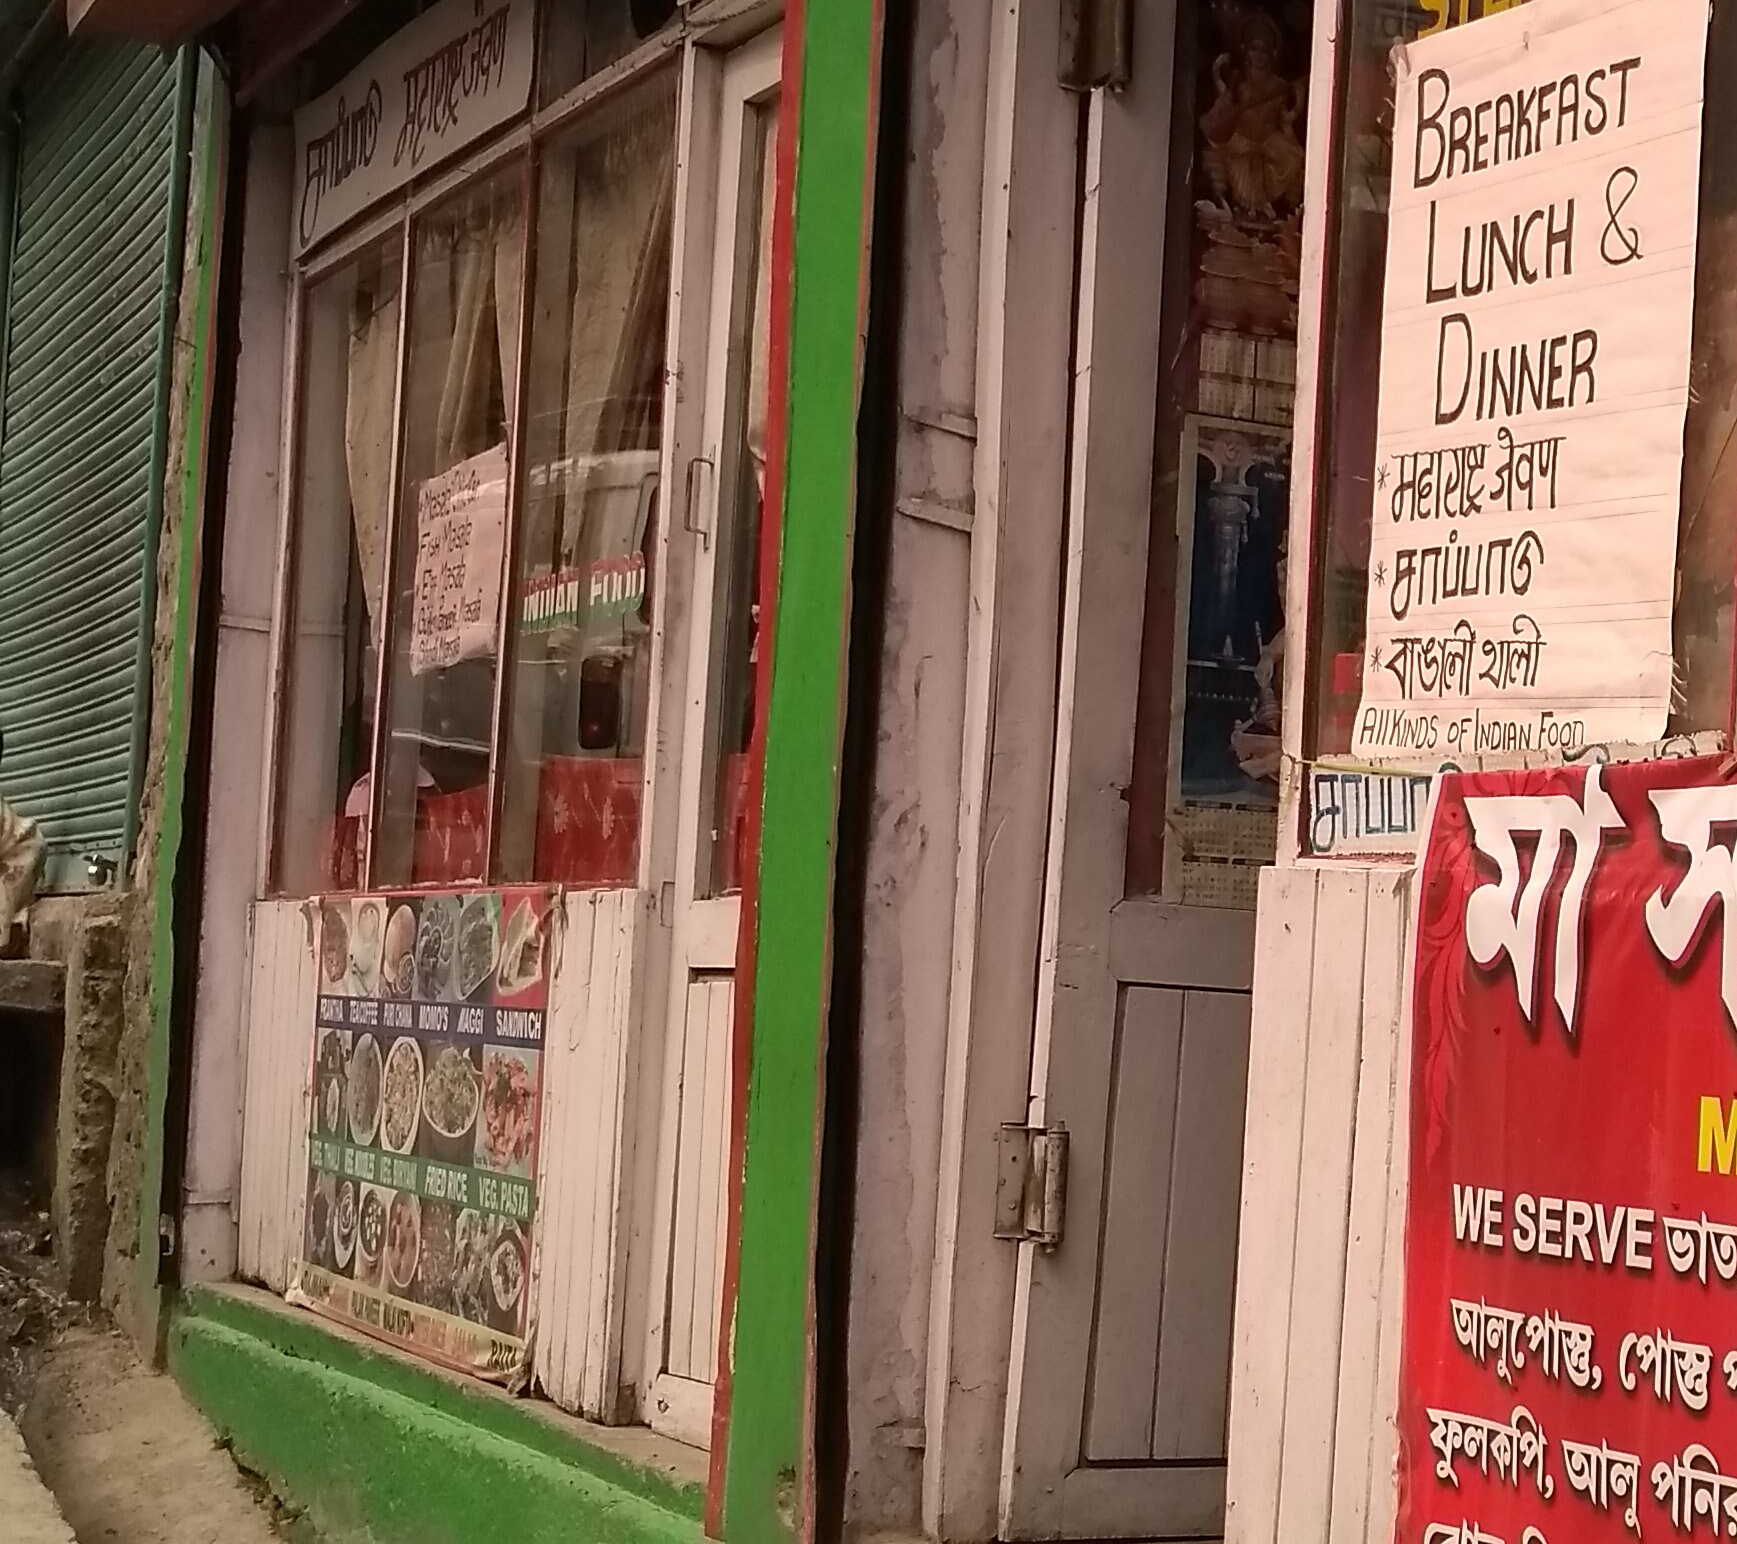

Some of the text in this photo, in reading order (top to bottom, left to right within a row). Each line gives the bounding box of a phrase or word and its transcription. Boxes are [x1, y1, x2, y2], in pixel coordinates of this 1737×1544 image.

[1414, 56, 1641, 189] BREAKFAST
[1426, 166, 1644, 304] LUNCH &
[1435, 313, 1597, 425] DINNER
[1489, 426, 1567, 511] जेवण
[1391, 529, 1544, 620] சாப்பாடு
[1474, 707, 1531, 753] INDIAN
[1463, 764, 1626, 1035] মা
[419, 1006, 448, 1032] MOMO'S
[496, 1010, 542, 1040] SANDWICH
[424, 1164, 447, 1197] FRIED
[448, 1170, 468, 1203] RICE
[501, 1181, 529, 1217] PASTA
[1453, 1183, 1502, 1246] WE
[1513, 1194, 1655, 1270] SERVE
[1426, 1405, 1554, 1499] ফুলকপি,
[1562, 1437, 1642, 1538] আলু
